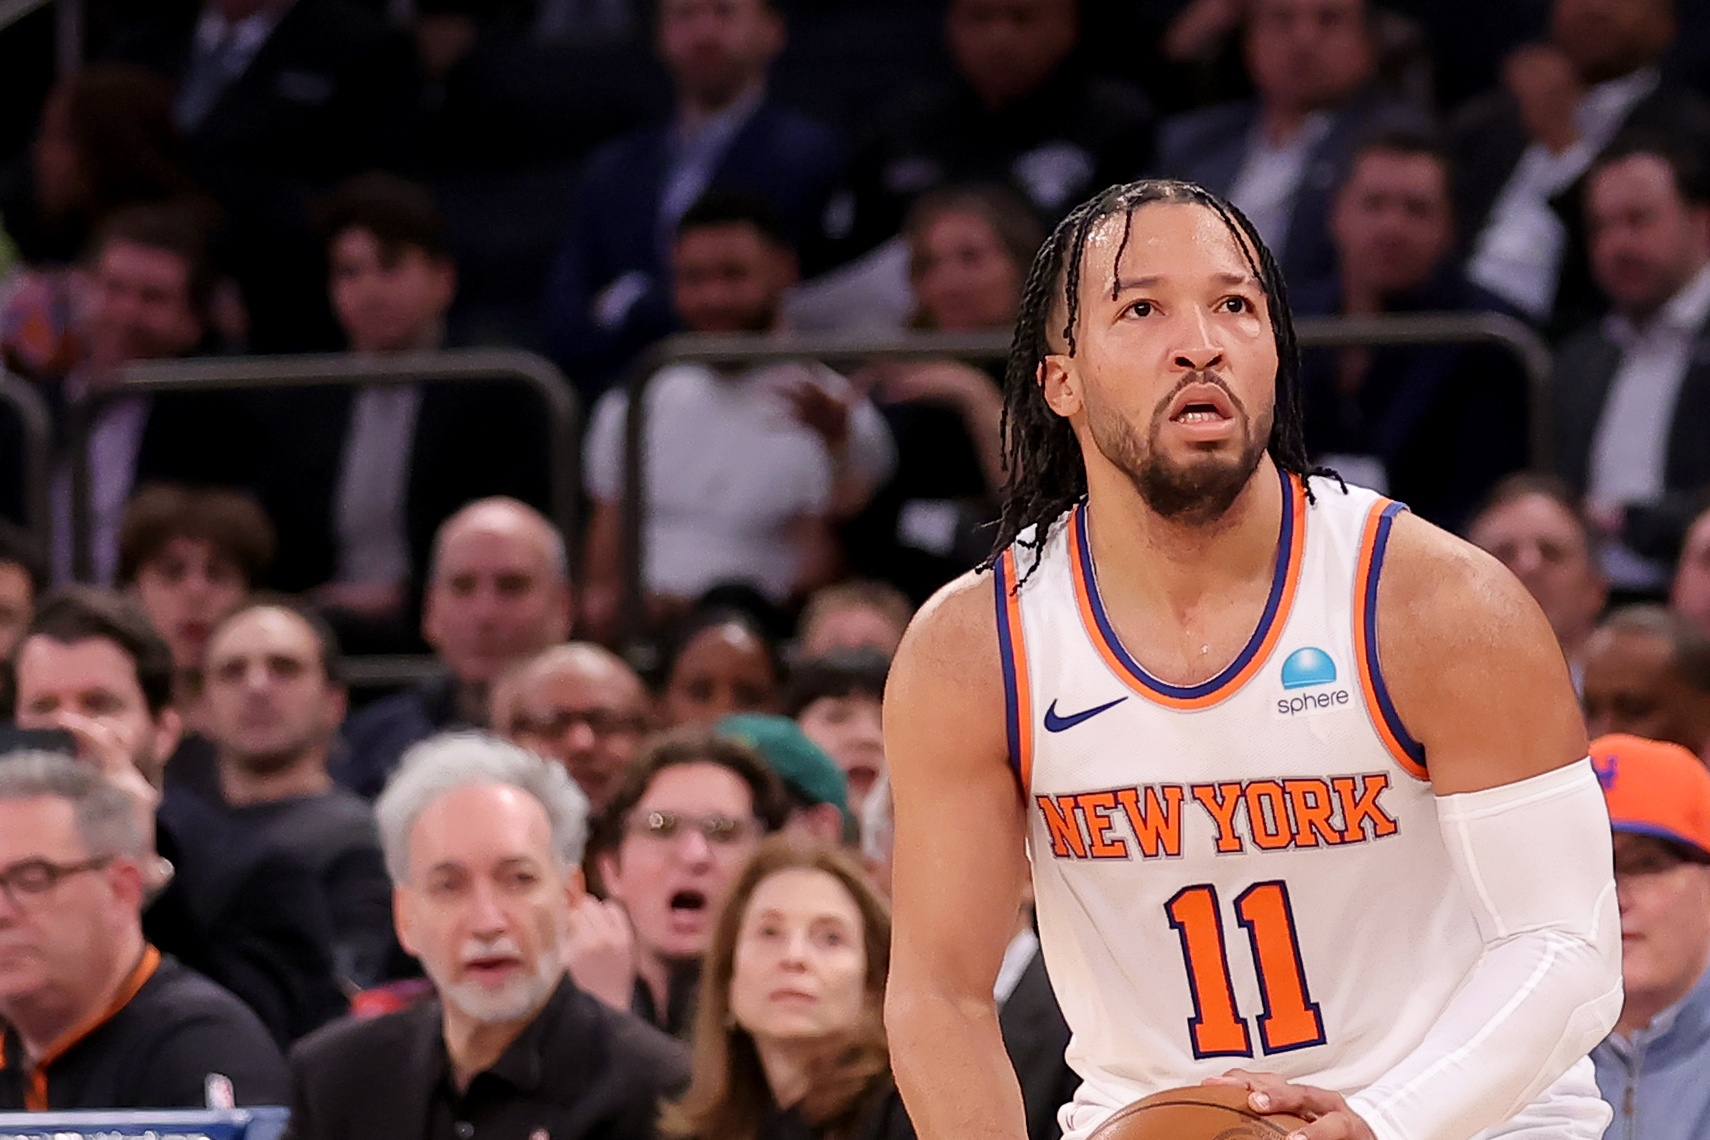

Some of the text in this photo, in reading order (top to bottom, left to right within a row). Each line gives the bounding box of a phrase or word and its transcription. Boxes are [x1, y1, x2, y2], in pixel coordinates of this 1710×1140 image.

[1277, 689, 1349, 716] sphere
[1036, 772, 1399, 859] NEW YORK
[1163, 879, 1327, 1060] 11
